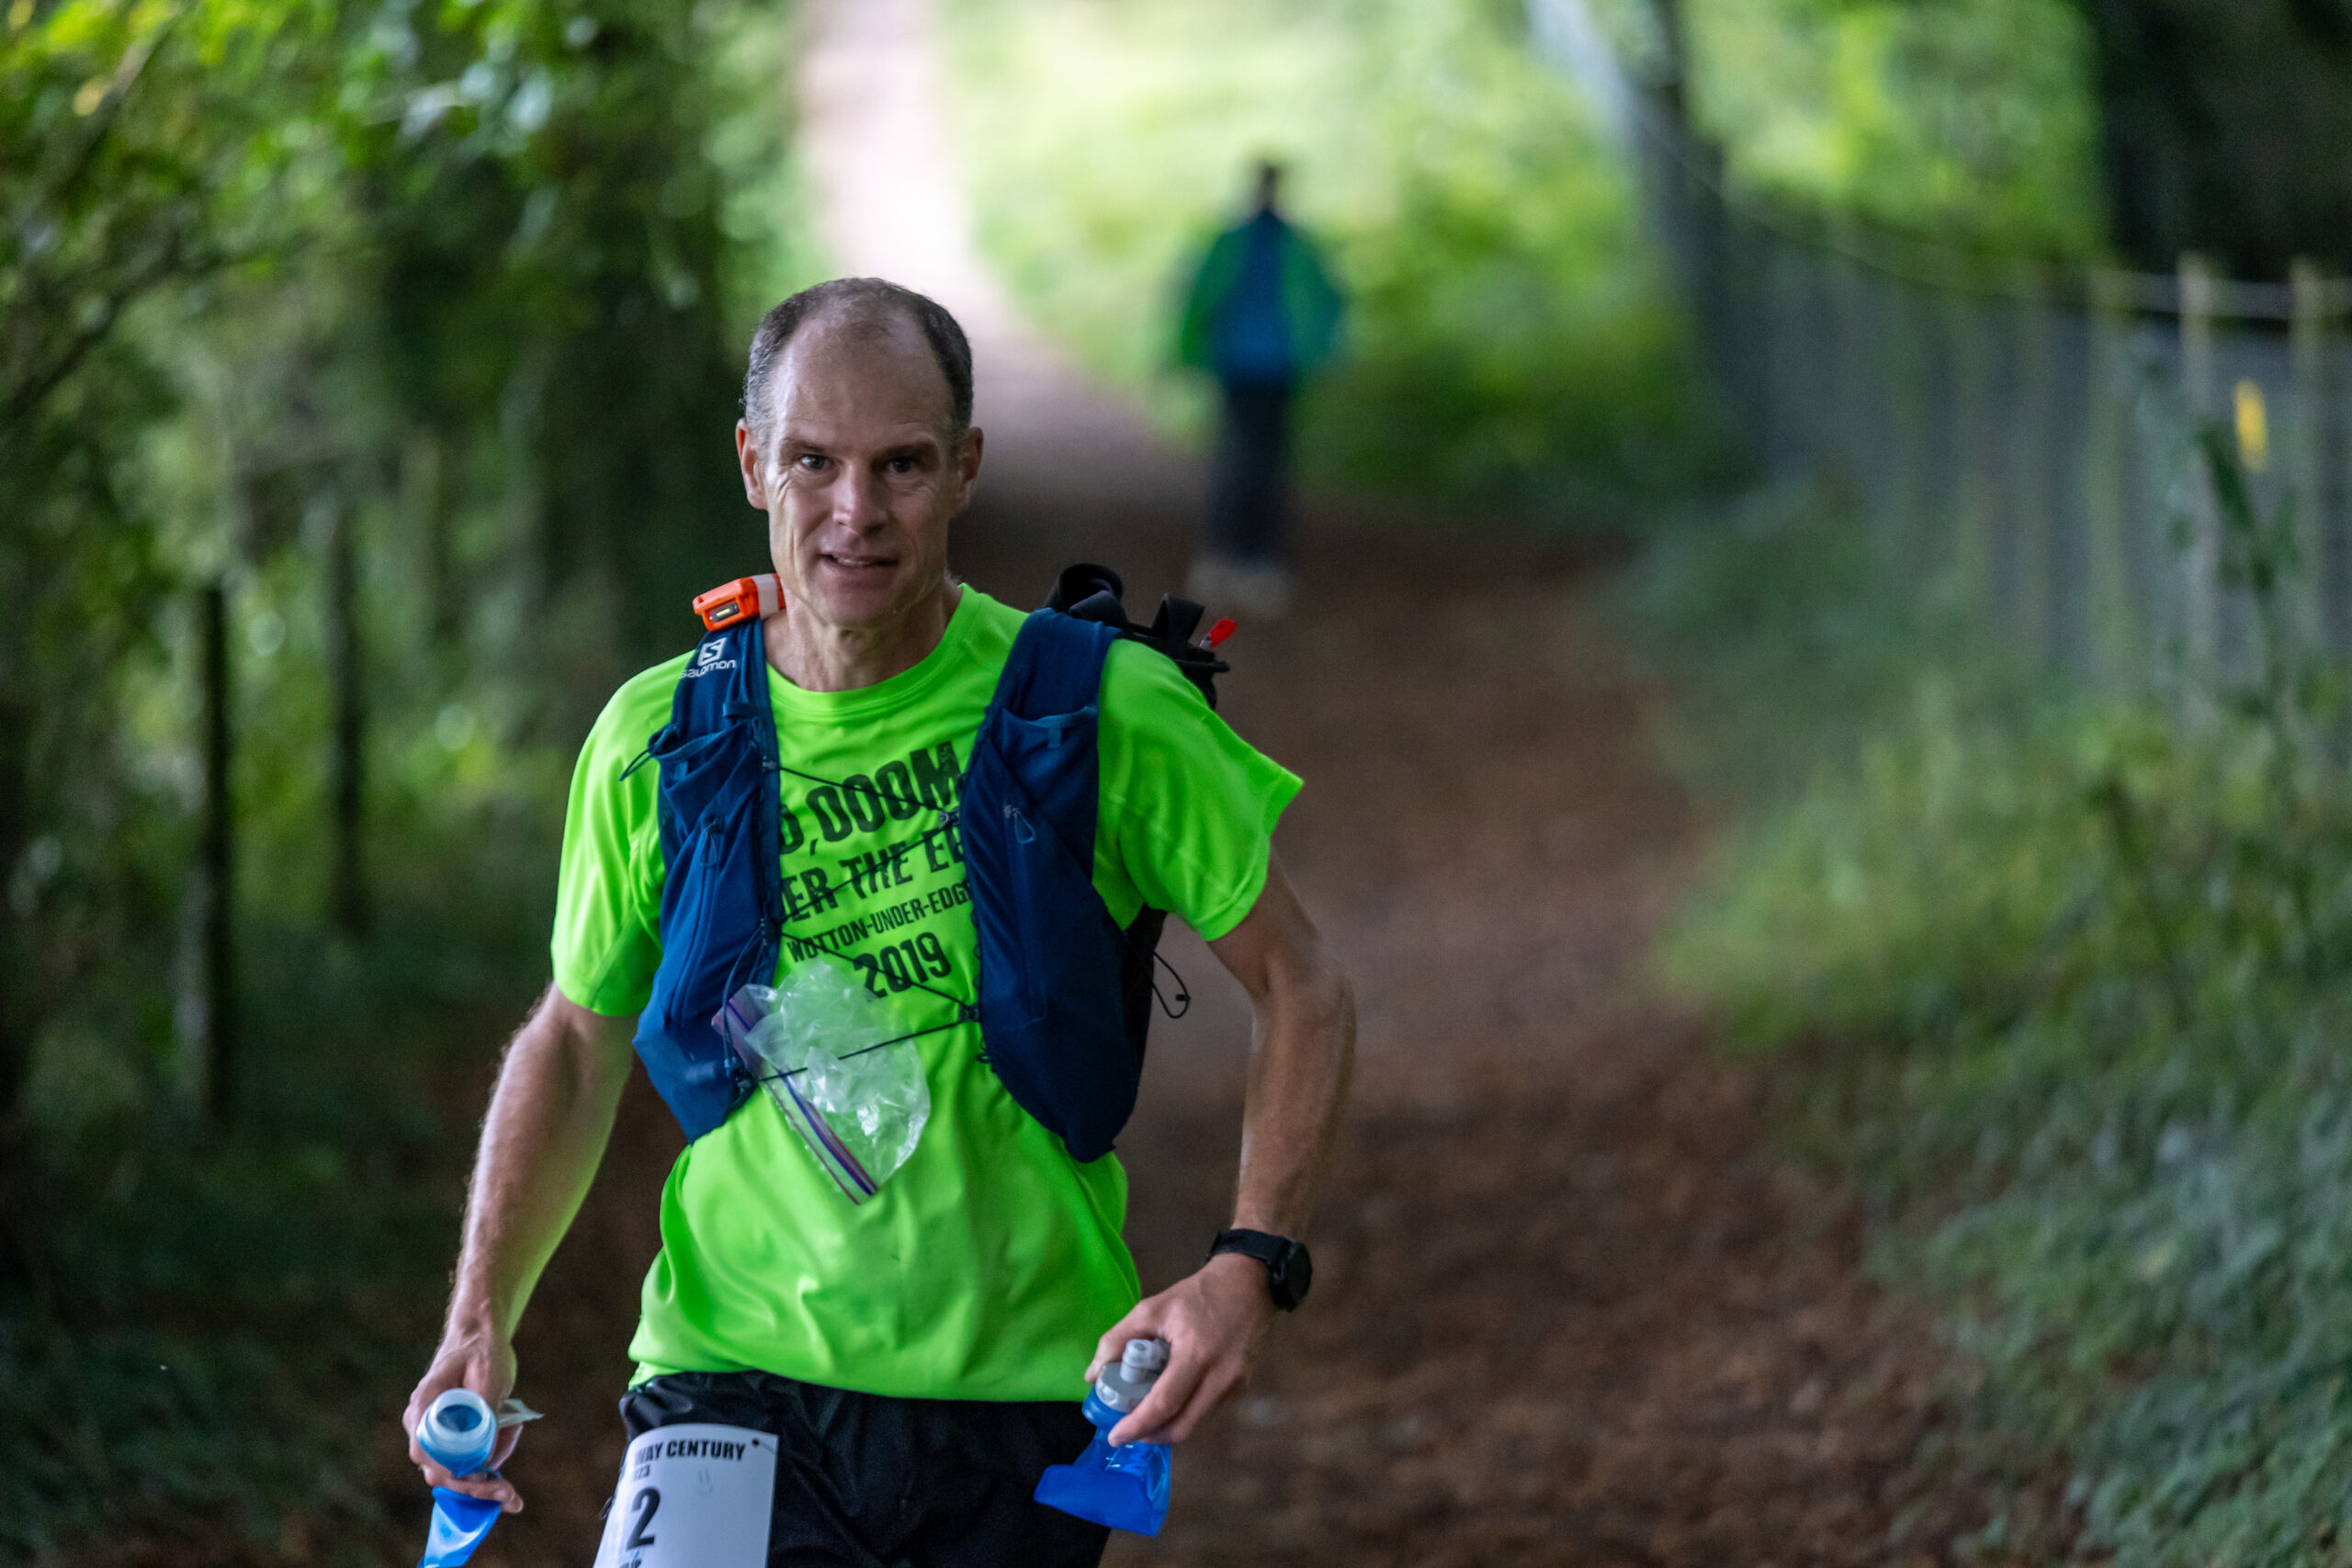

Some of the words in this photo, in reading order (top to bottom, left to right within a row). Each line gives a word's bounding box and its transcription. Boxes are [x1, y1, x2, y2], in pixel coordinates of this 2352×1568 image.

[837, 840, 913, 901] THE
[786, 879, 972, 964] WOTTON-UNDER-EDG
[853, 931, 952, 999] 2019
[666, 1438, 746, 1461] CENTURY
